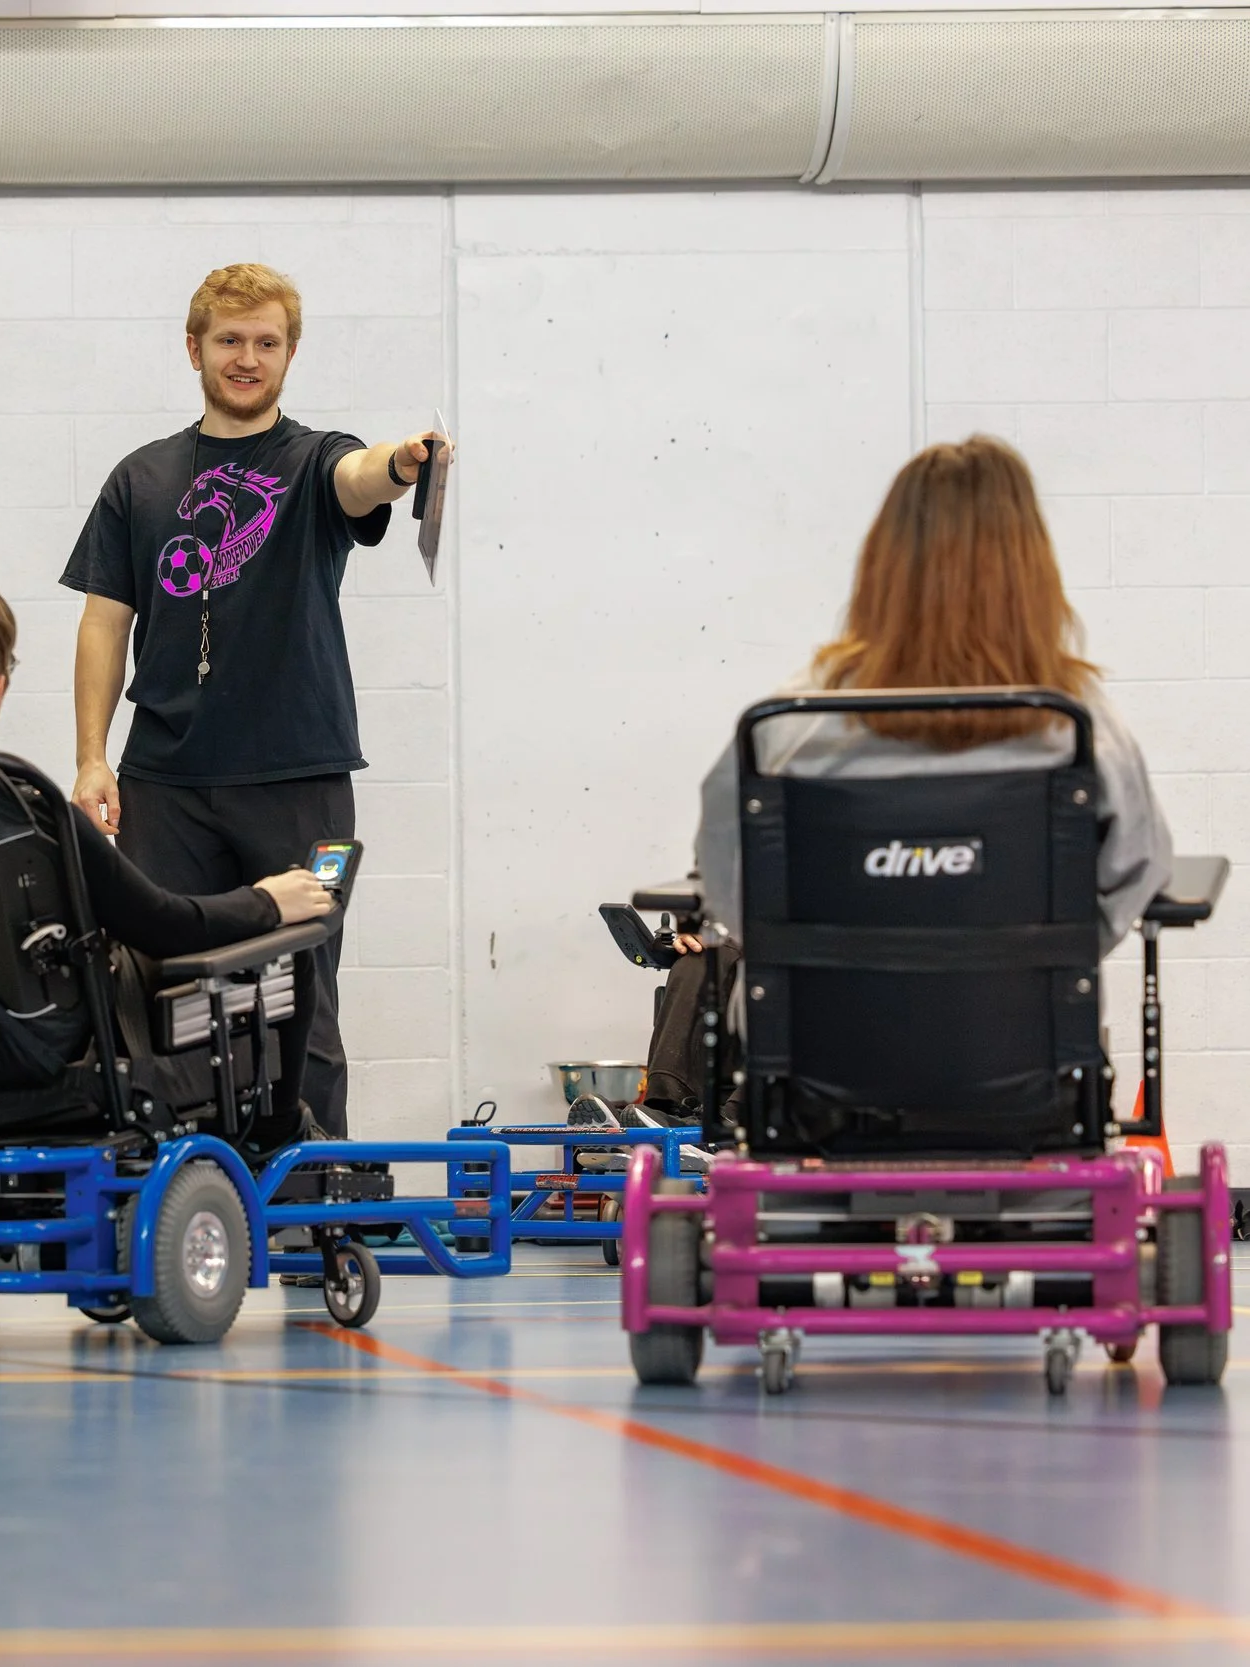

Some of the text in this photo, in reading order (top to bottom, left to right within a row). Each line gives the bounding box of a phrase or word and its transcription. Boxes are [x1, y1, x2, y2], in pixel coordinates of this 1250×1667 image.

[231, 507, 265, 540] LETHBRIDGE
[214, 527, 266, 575] HORSEPOWER
[864, 840, 975, 877] drive
